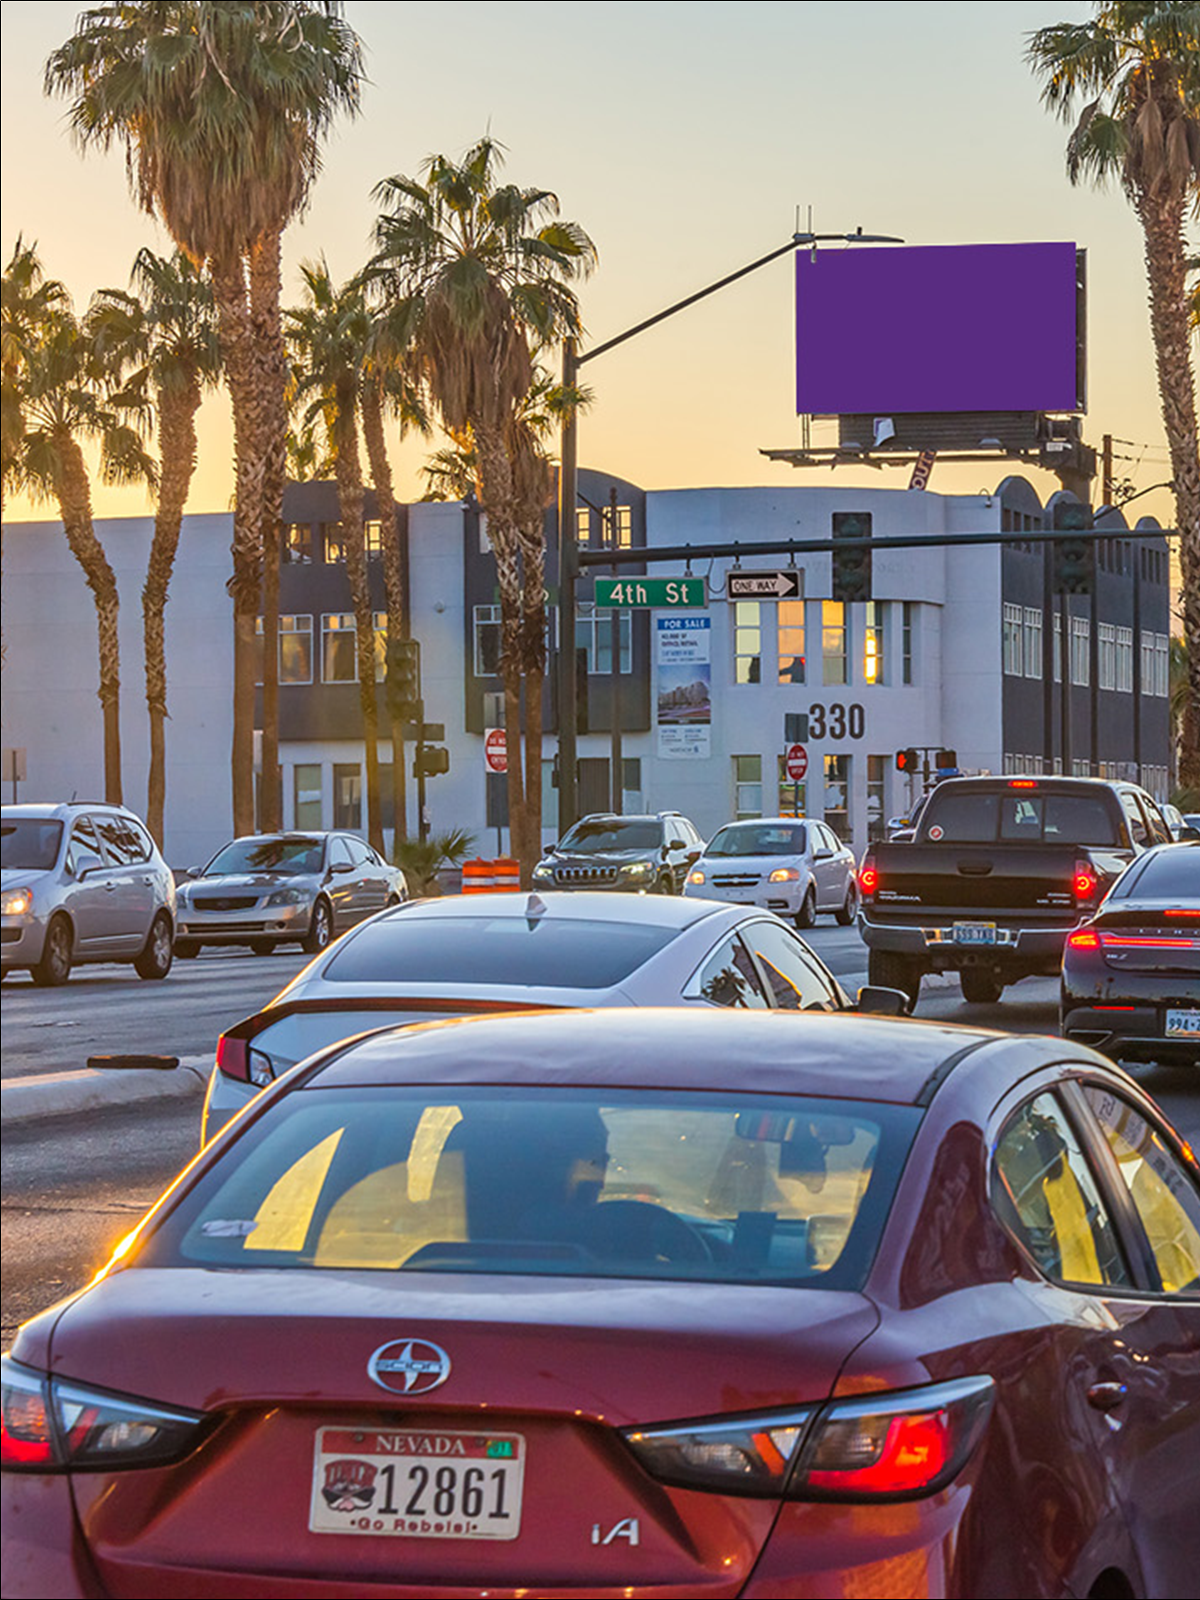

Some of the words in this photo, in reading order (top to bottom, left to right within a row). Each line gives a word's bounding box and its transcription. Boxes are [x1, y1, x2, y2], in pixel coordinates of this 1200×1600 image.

[610, 583, 647, 604] 4th
[666, 582, 689, 604] St
[734, 581, 752, 592] ONE
[757, 580, 777, 591] WAY
[809, 703, 865, 740] 330
[376, 1435, 466, 1456] NEVADA
[377, 1463, 510, 1519] 12861
[591, 1517, 640, 1546] iA
